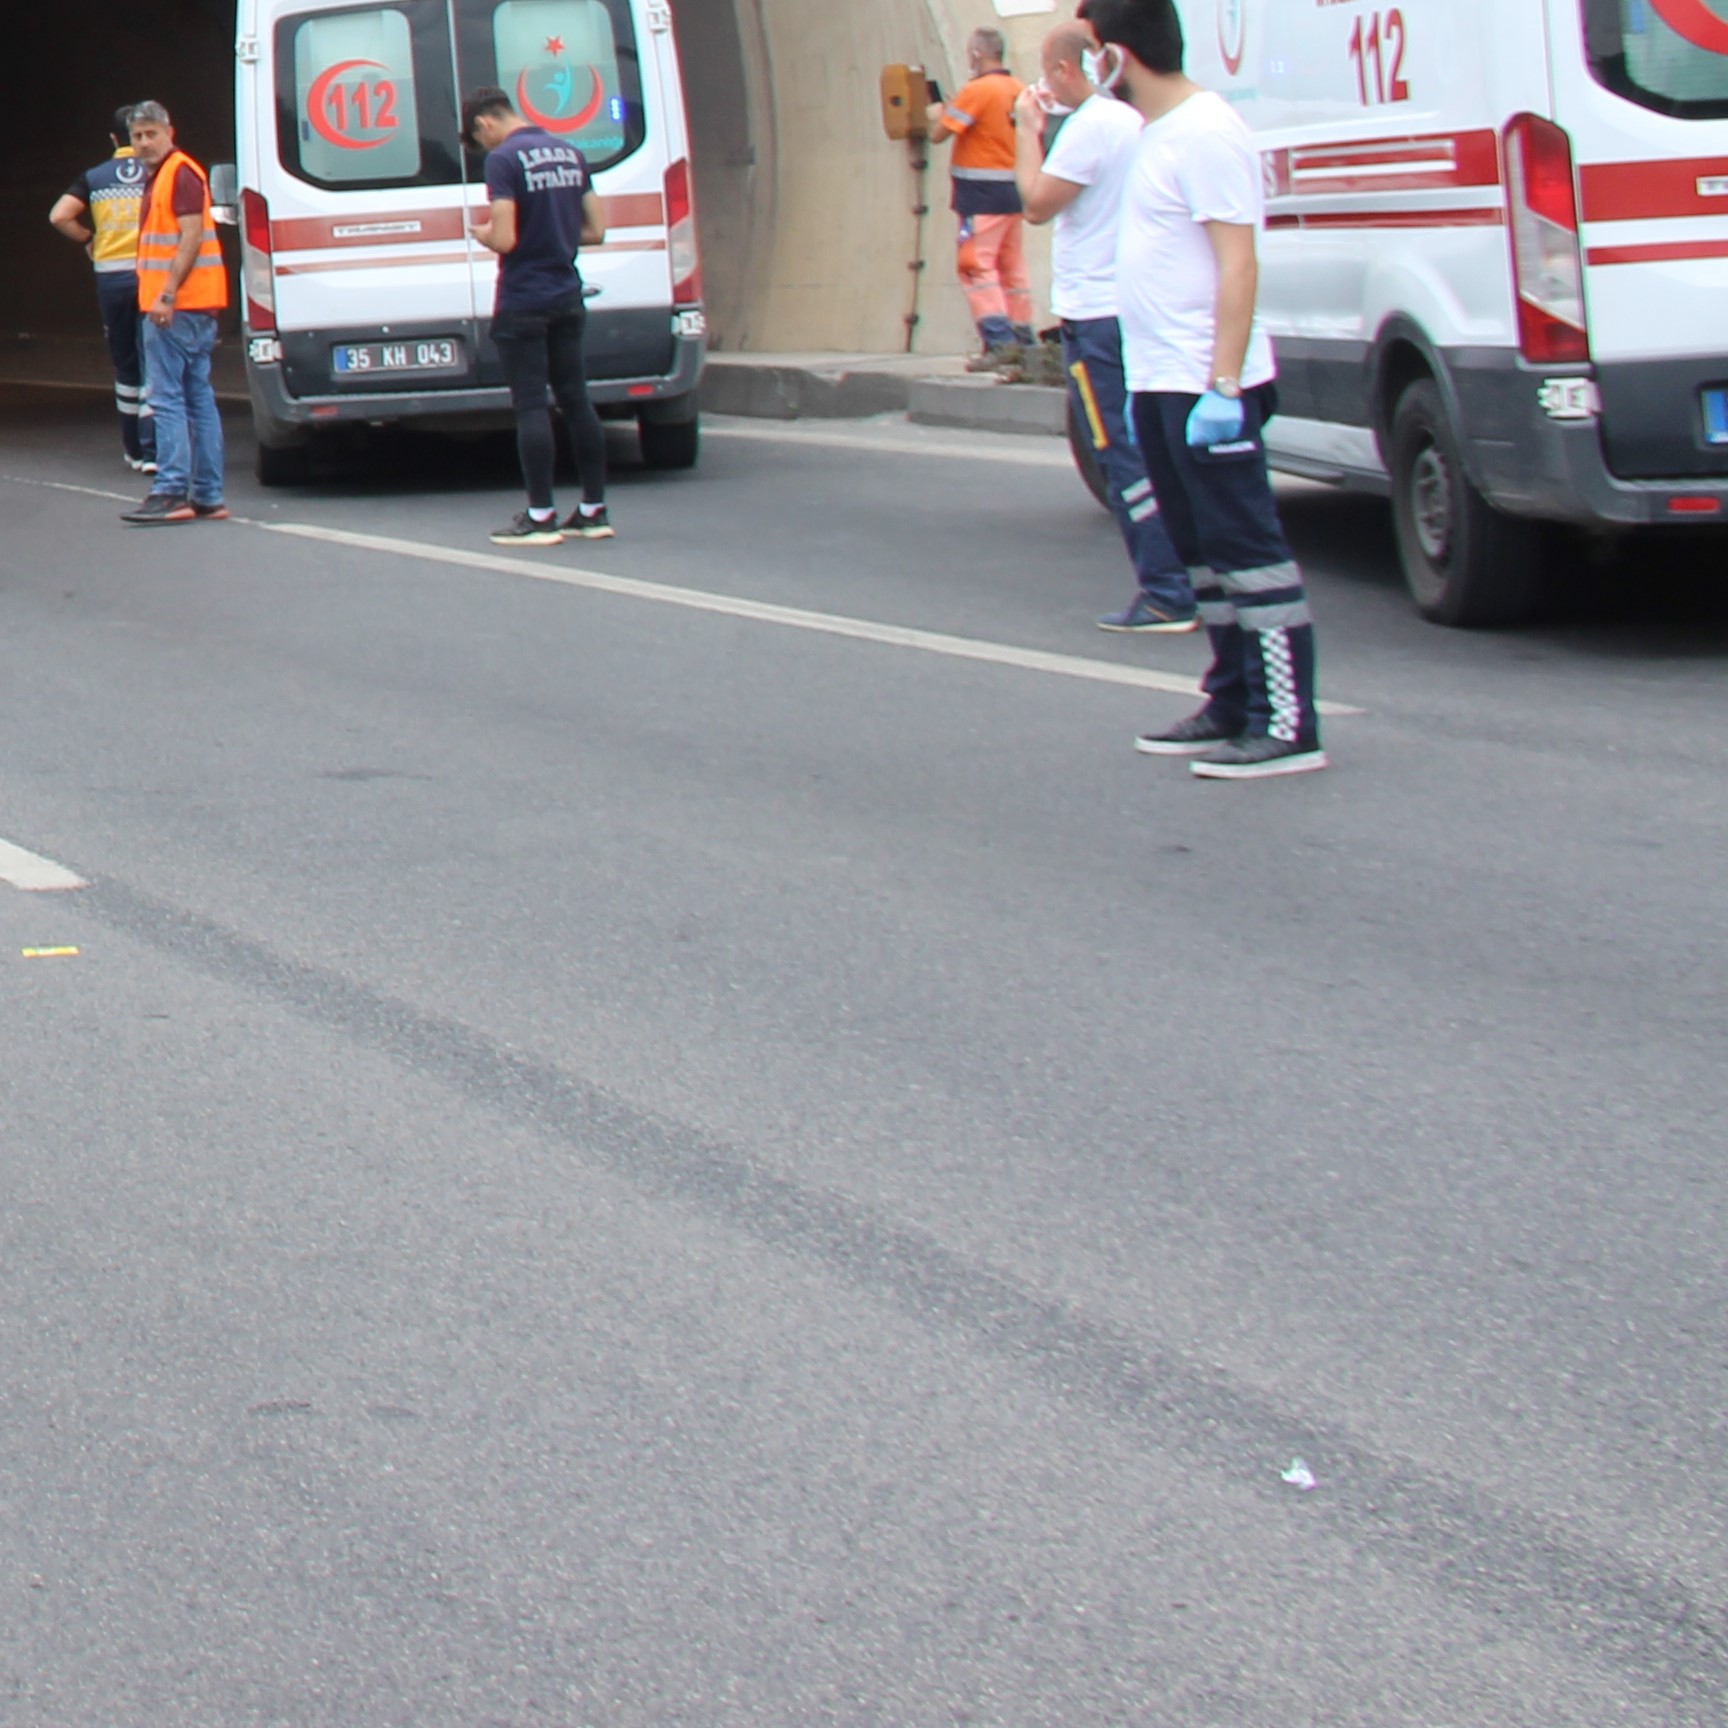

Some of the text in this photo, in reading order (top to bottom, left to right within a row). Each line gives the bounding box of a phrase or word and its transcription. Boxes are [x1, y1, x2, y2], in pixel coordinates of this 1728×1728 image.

[1347, 7, 1409, 107] 112
[328, 80, 400, 130] 112
[346, 342, 452, 369] 35 KH 043
